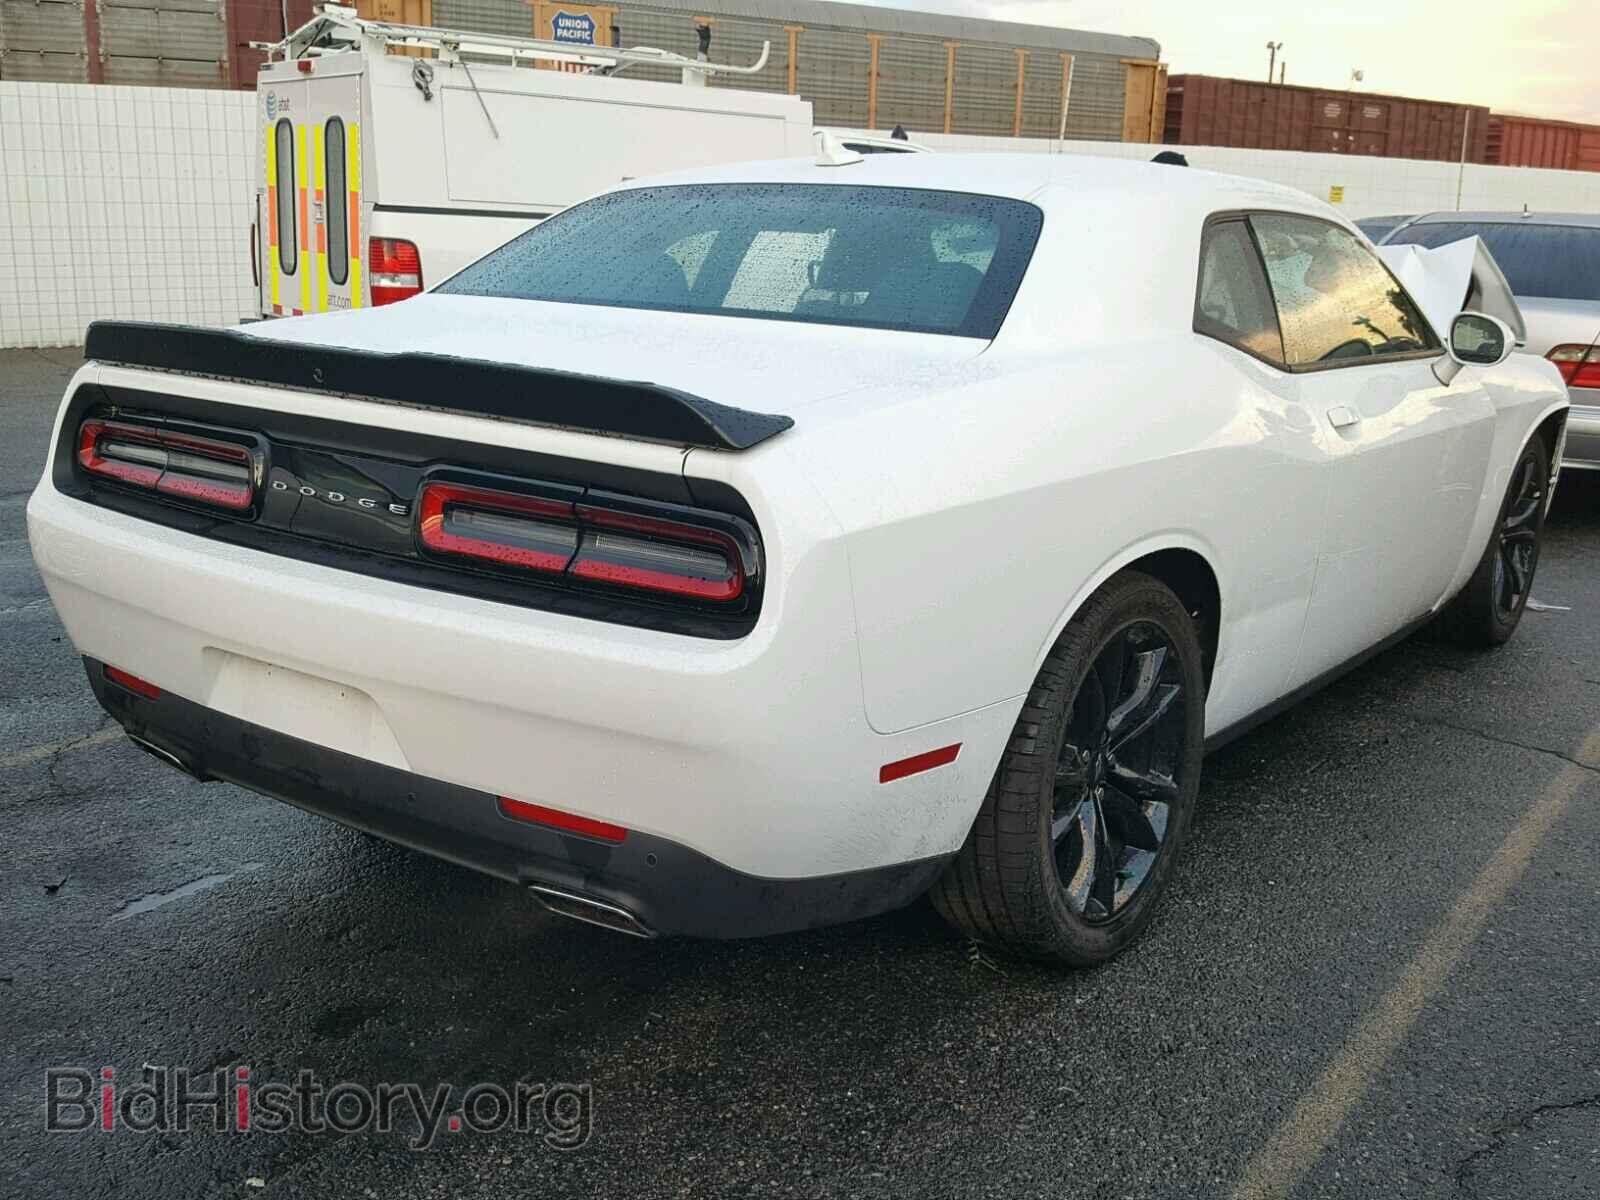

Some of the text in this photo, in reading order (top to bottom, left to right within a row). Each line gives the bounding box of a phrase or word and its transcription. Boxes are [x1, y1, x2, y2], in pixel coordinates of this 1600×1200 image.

[558, 17, 590, 29] UNION
[556, 28, 592, 40] PACIFIC
[272, 480, 408, 516] DODGE
